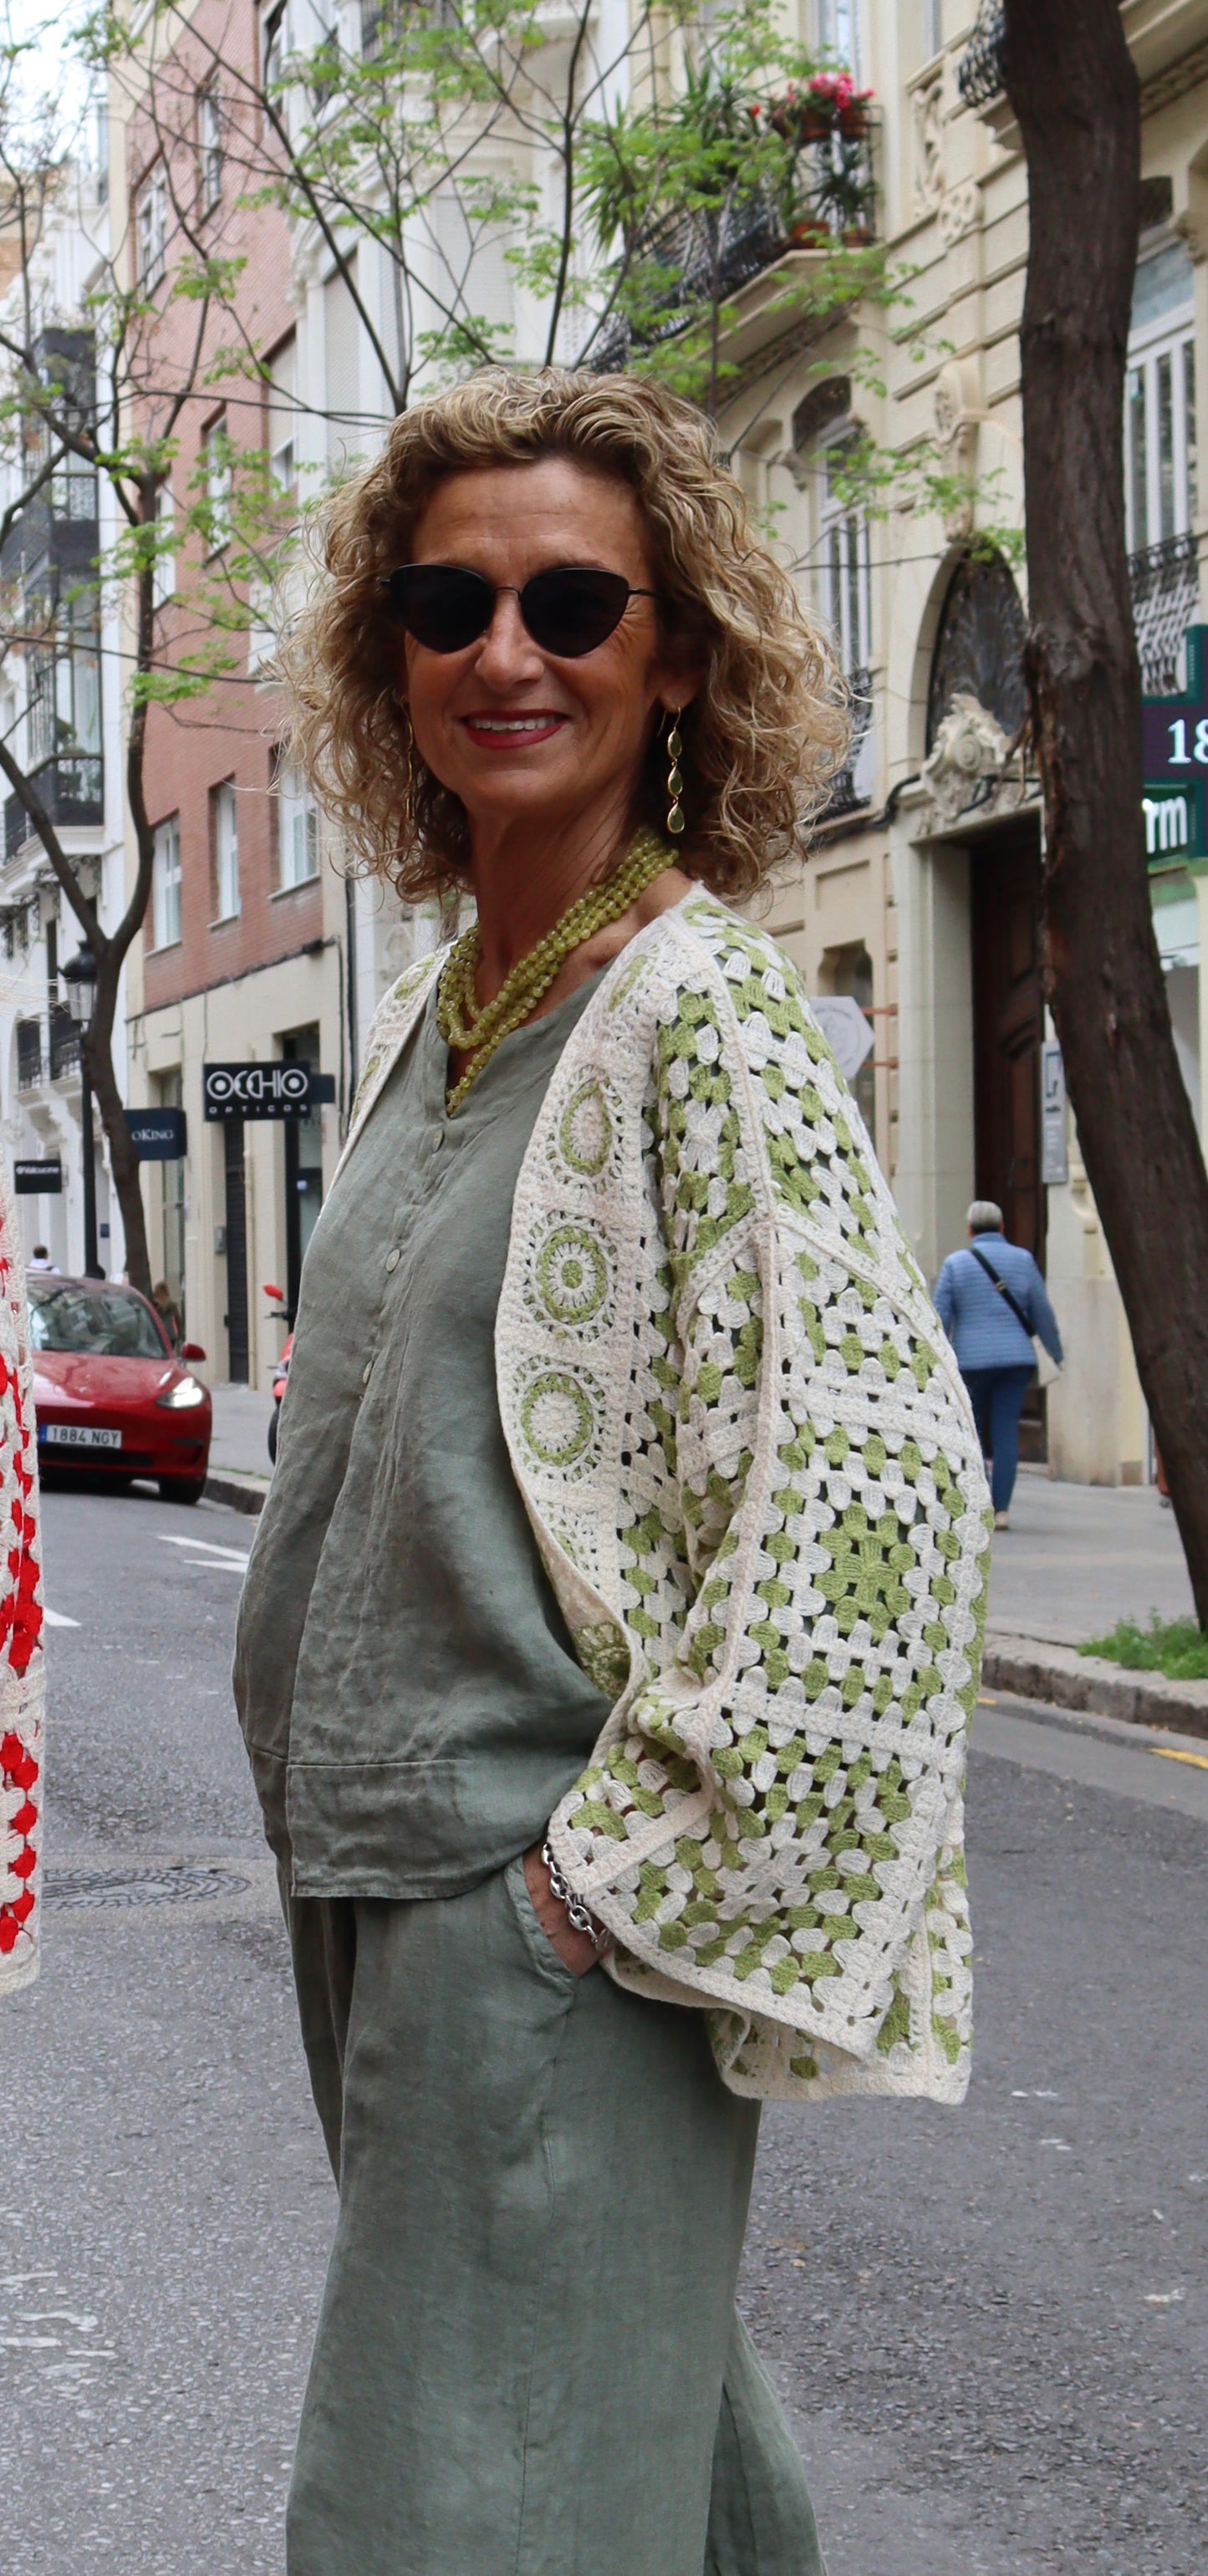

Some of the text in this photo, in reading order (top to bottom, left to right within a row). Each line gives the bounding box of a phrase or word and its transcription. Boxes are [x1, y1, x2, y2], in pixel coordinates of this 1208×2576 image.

[206, 1069, 308, 1100] OCCHIO
[53, 1428, 119, 1445] 1884 NGY
